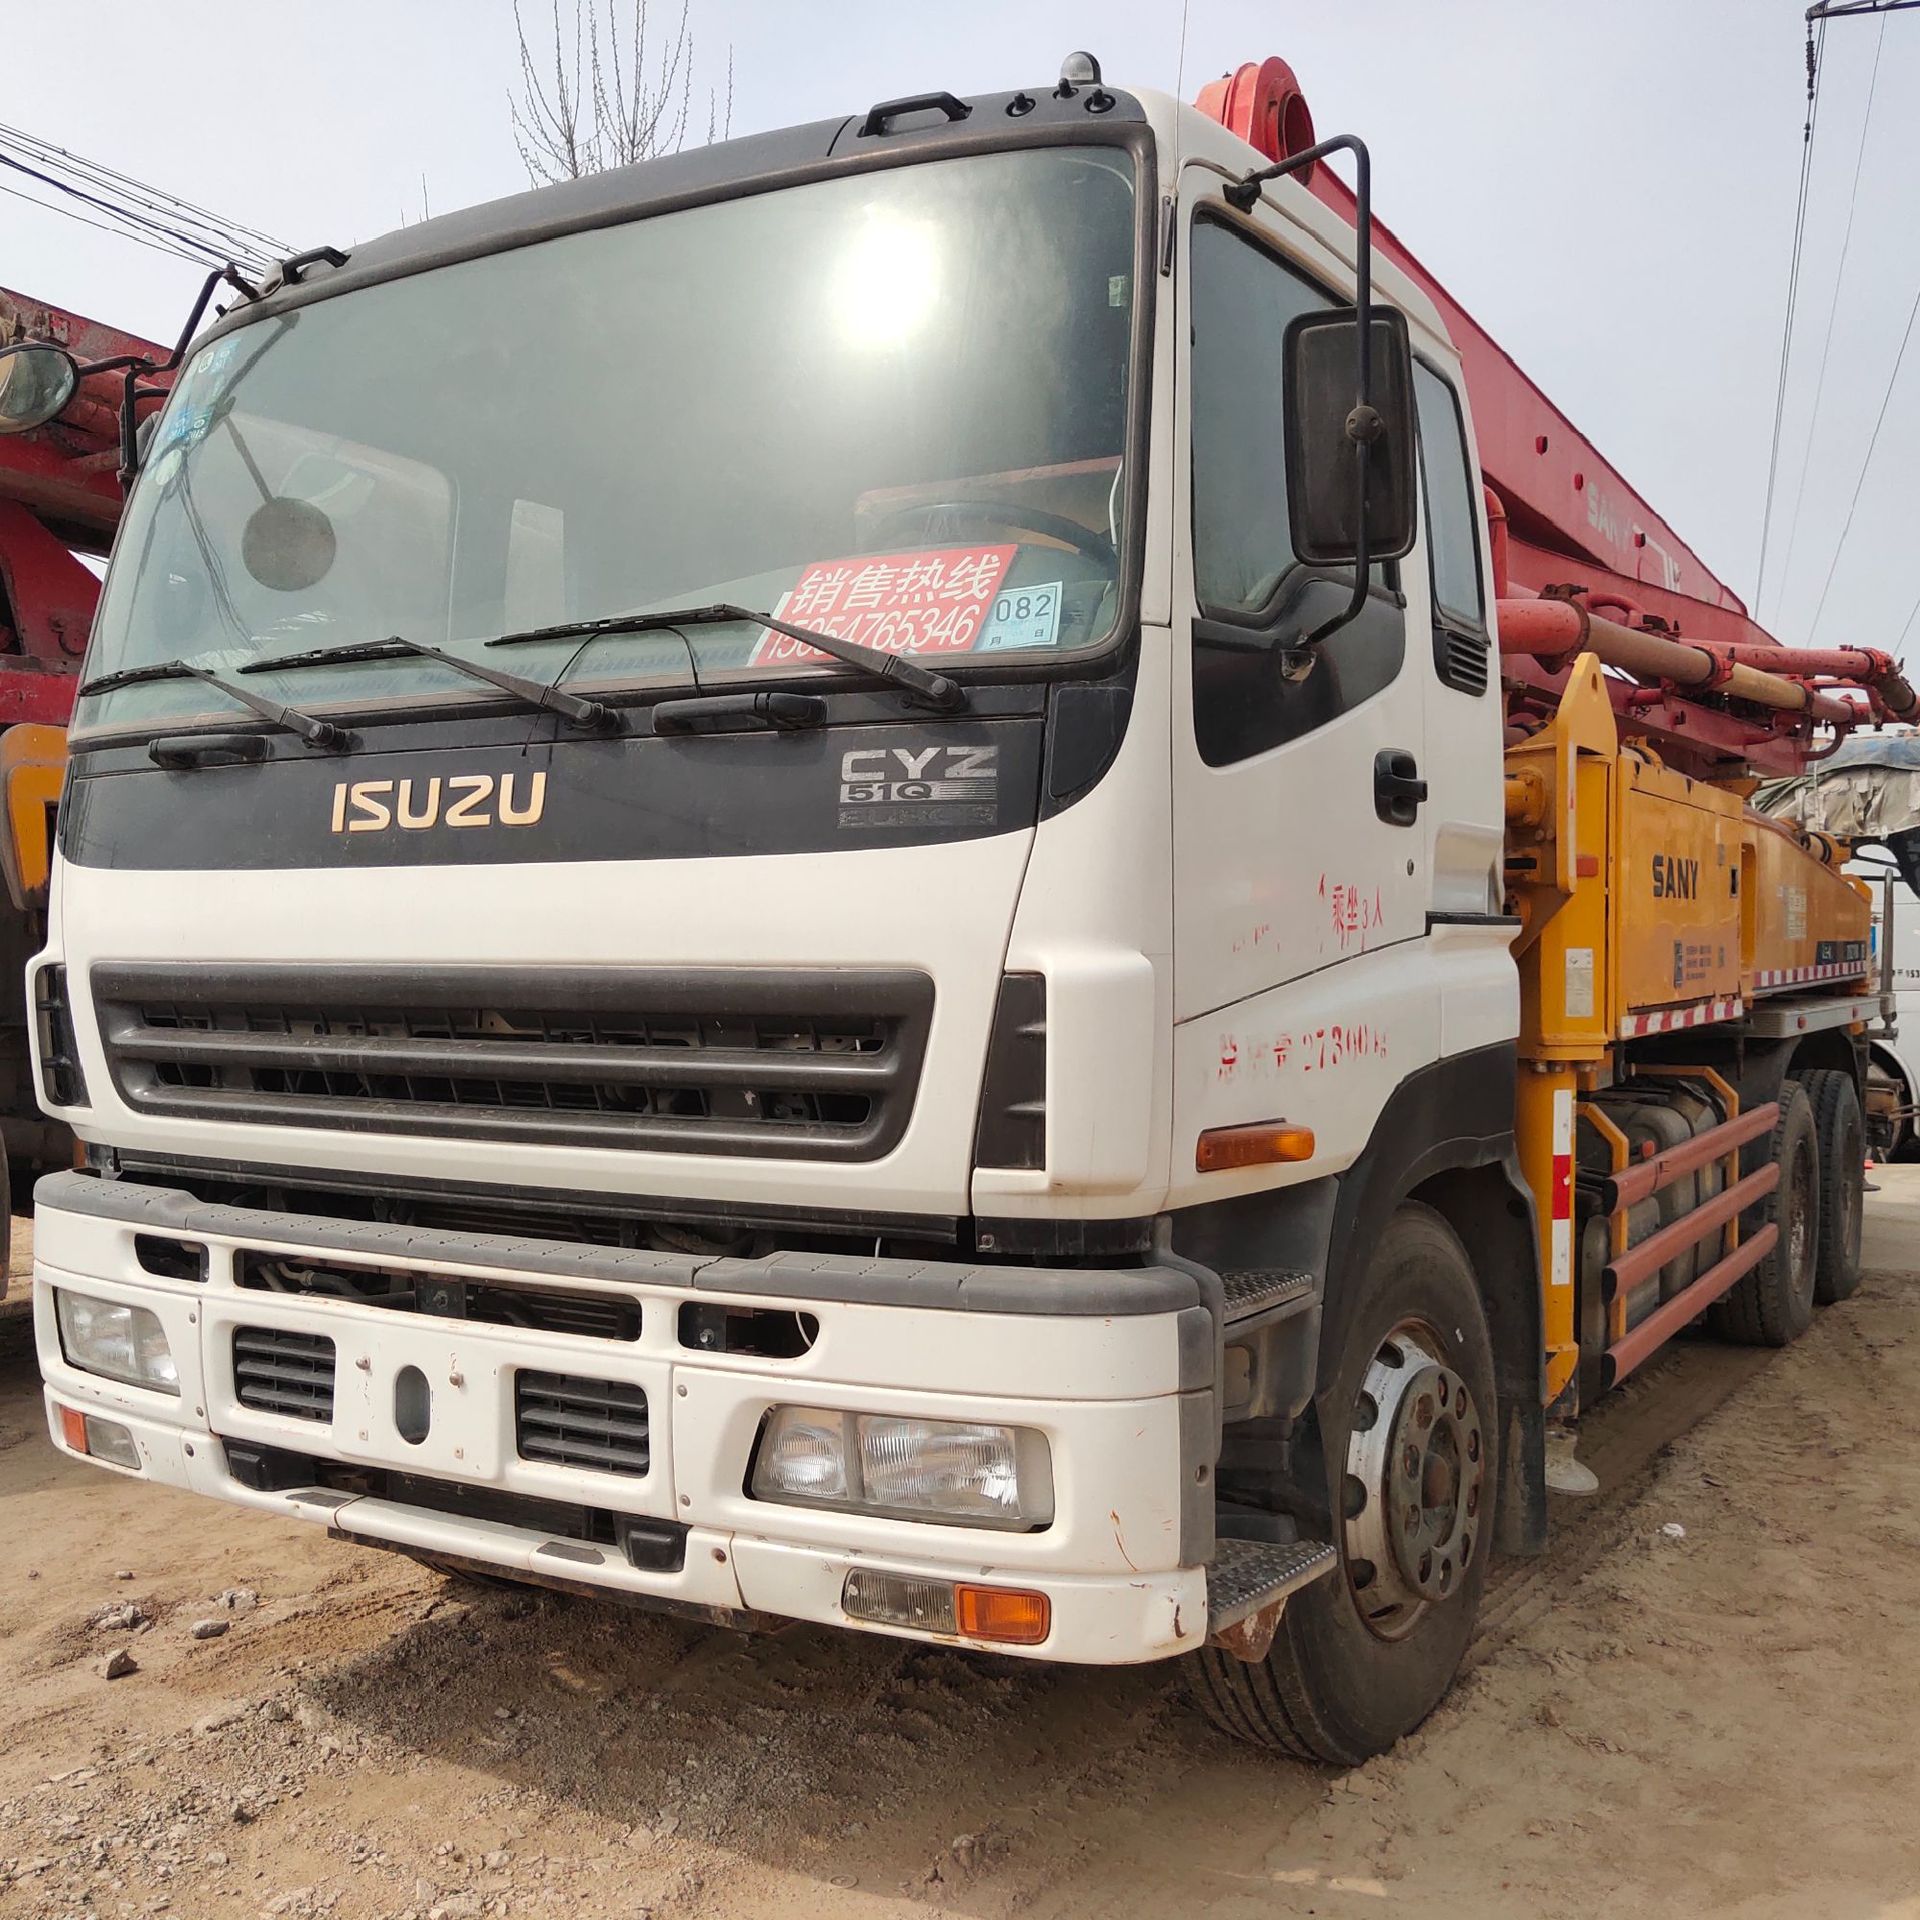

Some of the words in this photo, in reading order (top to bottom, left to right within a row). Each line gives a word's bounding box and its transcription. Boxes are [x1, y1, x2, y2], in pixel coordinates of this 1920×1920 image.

[790, 553, 1001, 615] 销售热线
[996, 594, 1051, 622] 082
[841, 746, 998, 782] CYZ
[331, 771, 547, 833] ISUZU
[847, 782, 933, 801] 51Q
[1652, 854, 1699, 900] SANY
[1318, 872, 1384, 936] 乘坐3人
